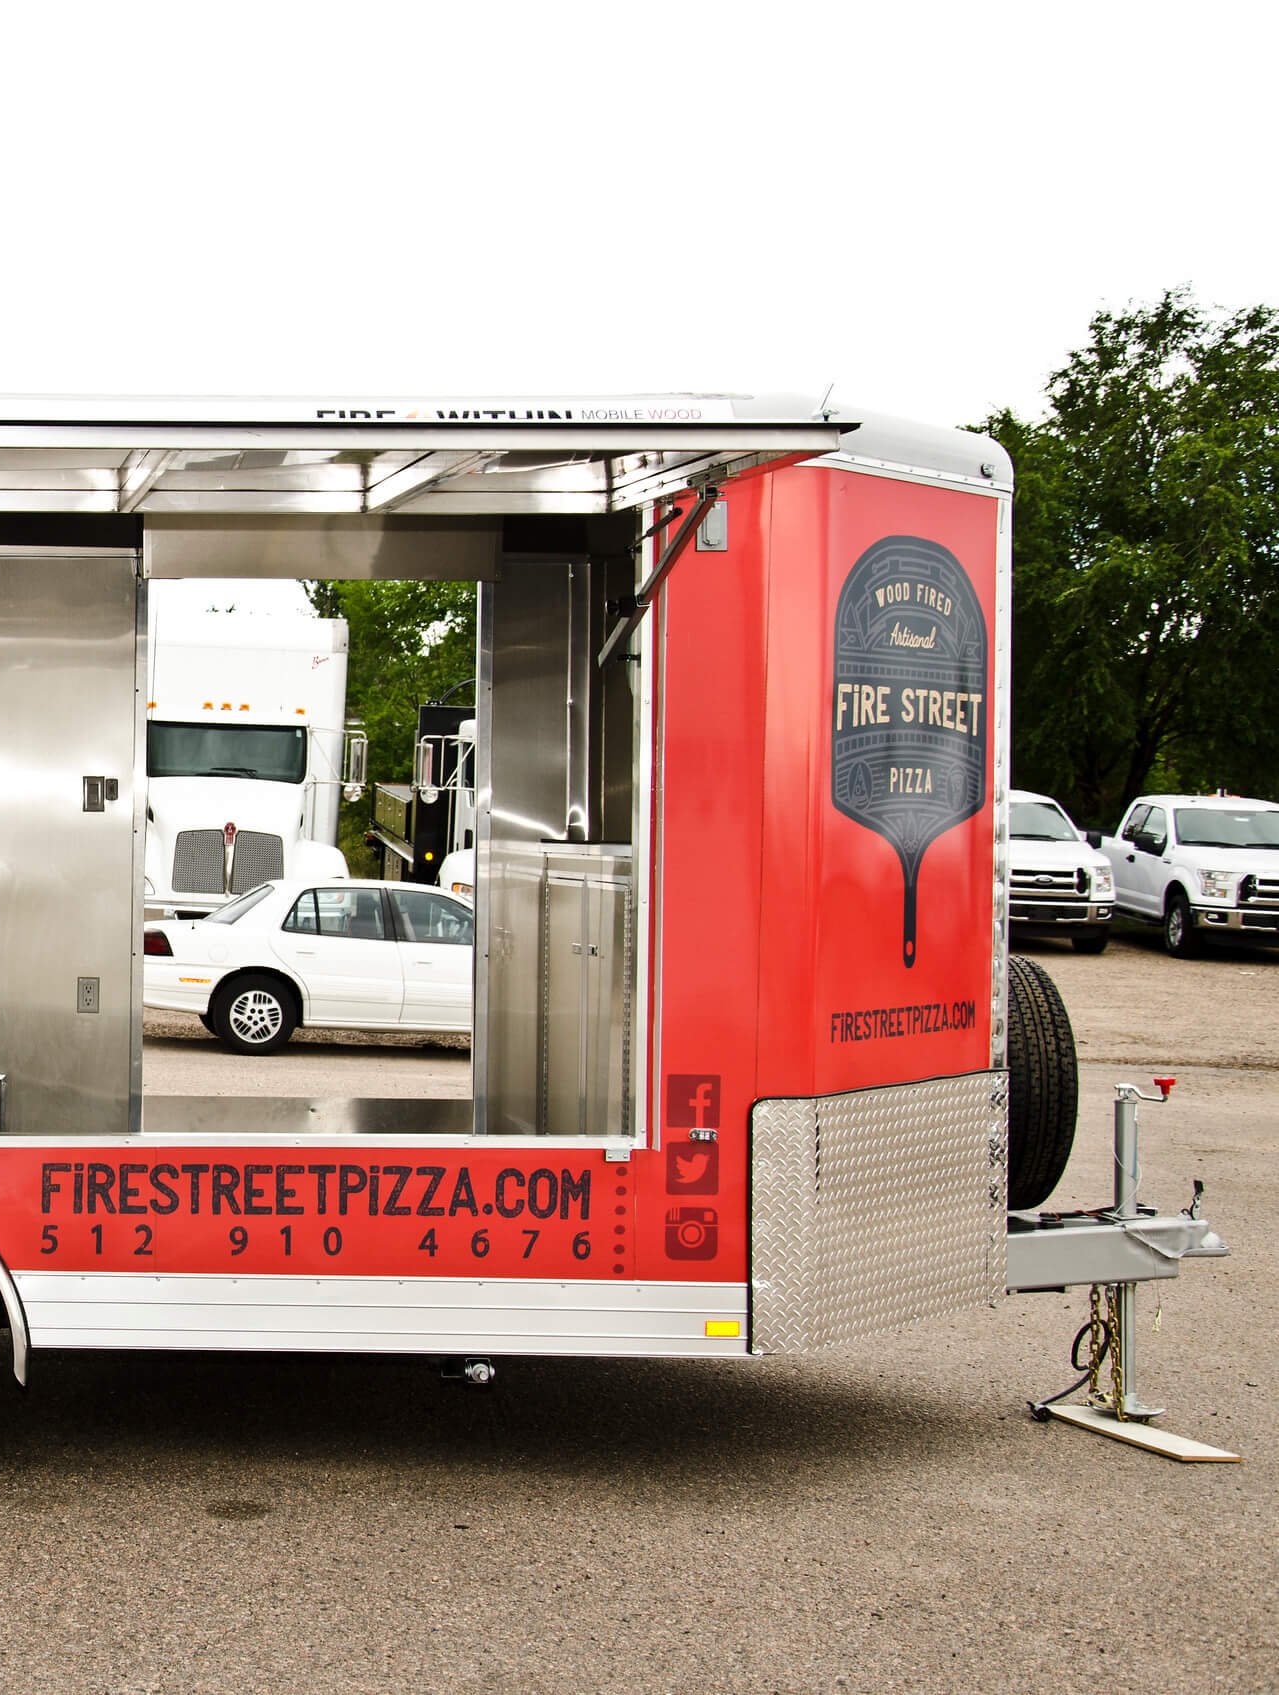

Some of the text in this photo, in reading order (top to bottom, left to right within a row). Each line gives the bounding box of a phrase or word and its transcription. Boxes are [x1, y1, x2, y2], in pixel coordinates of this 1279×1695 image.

[581, 409, 645, 420] MOBILE
[648, 408, 702, 420] WOOD
[875, 582, 910, 608] WOOD
[889, 621, 937, 649] Artisanal
[900, 687, 983, 736] STREET
